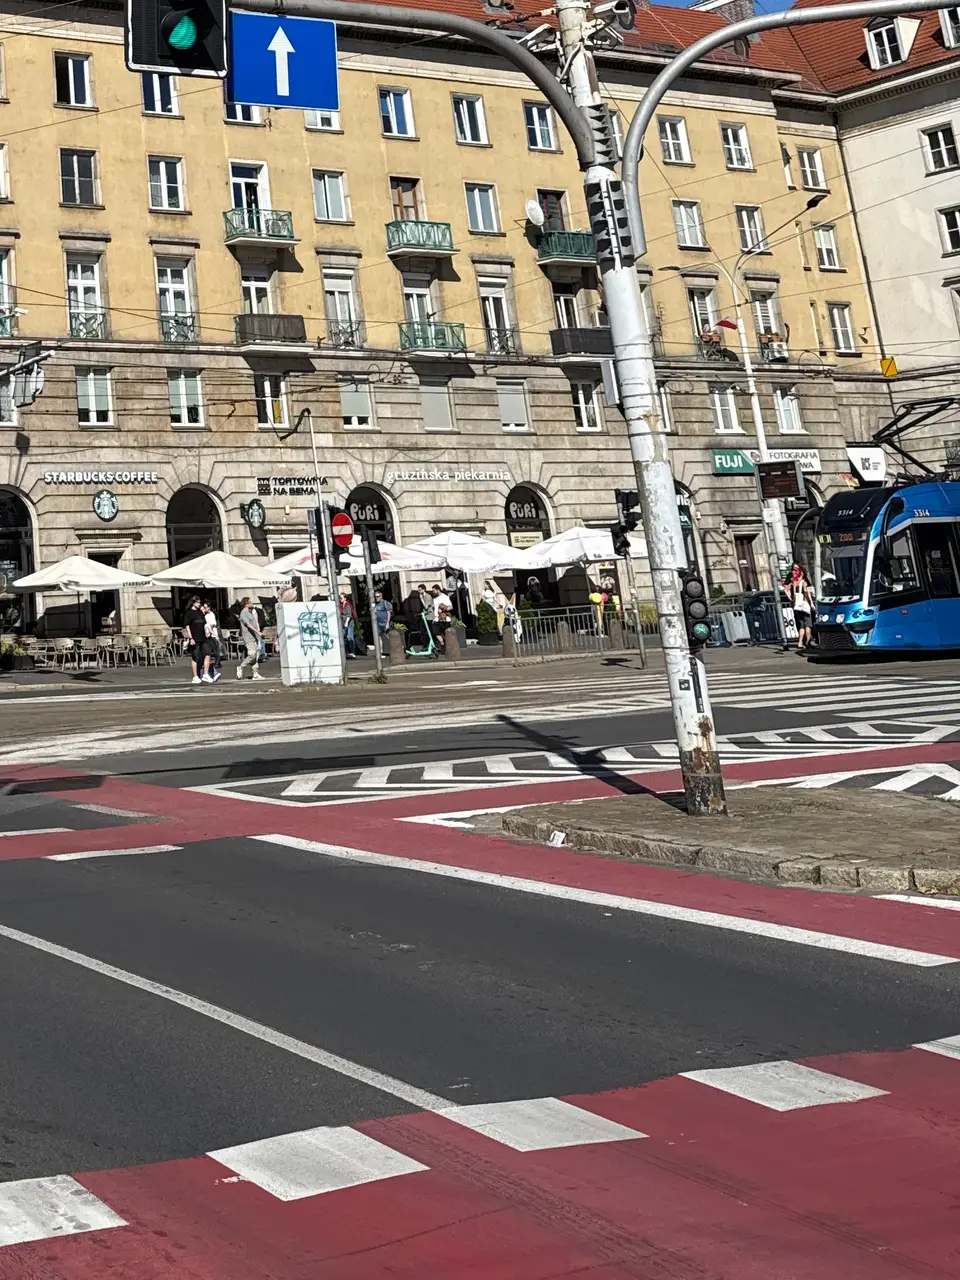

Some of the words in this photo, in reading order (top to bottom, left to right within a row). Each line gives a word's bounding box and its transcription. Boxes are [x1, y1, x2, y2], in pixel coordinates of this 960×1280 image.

[768, 451, 819, 459] FOTOGRAFIA
[714, 454, 743, 468] FUJI
[44, 471, 115, 483] STARBUCKS
[115, 471, 158, 483] COFFEE
[386, 468, 450, 483] gruzińska
[454, 468, 511, 482] piekarnia
[273, 486, 288, 496] NA
[289, 486, 316, 496] BEMA
[837, 509, 854, 517] 3314
[913, 509, 930, 517] 3314
